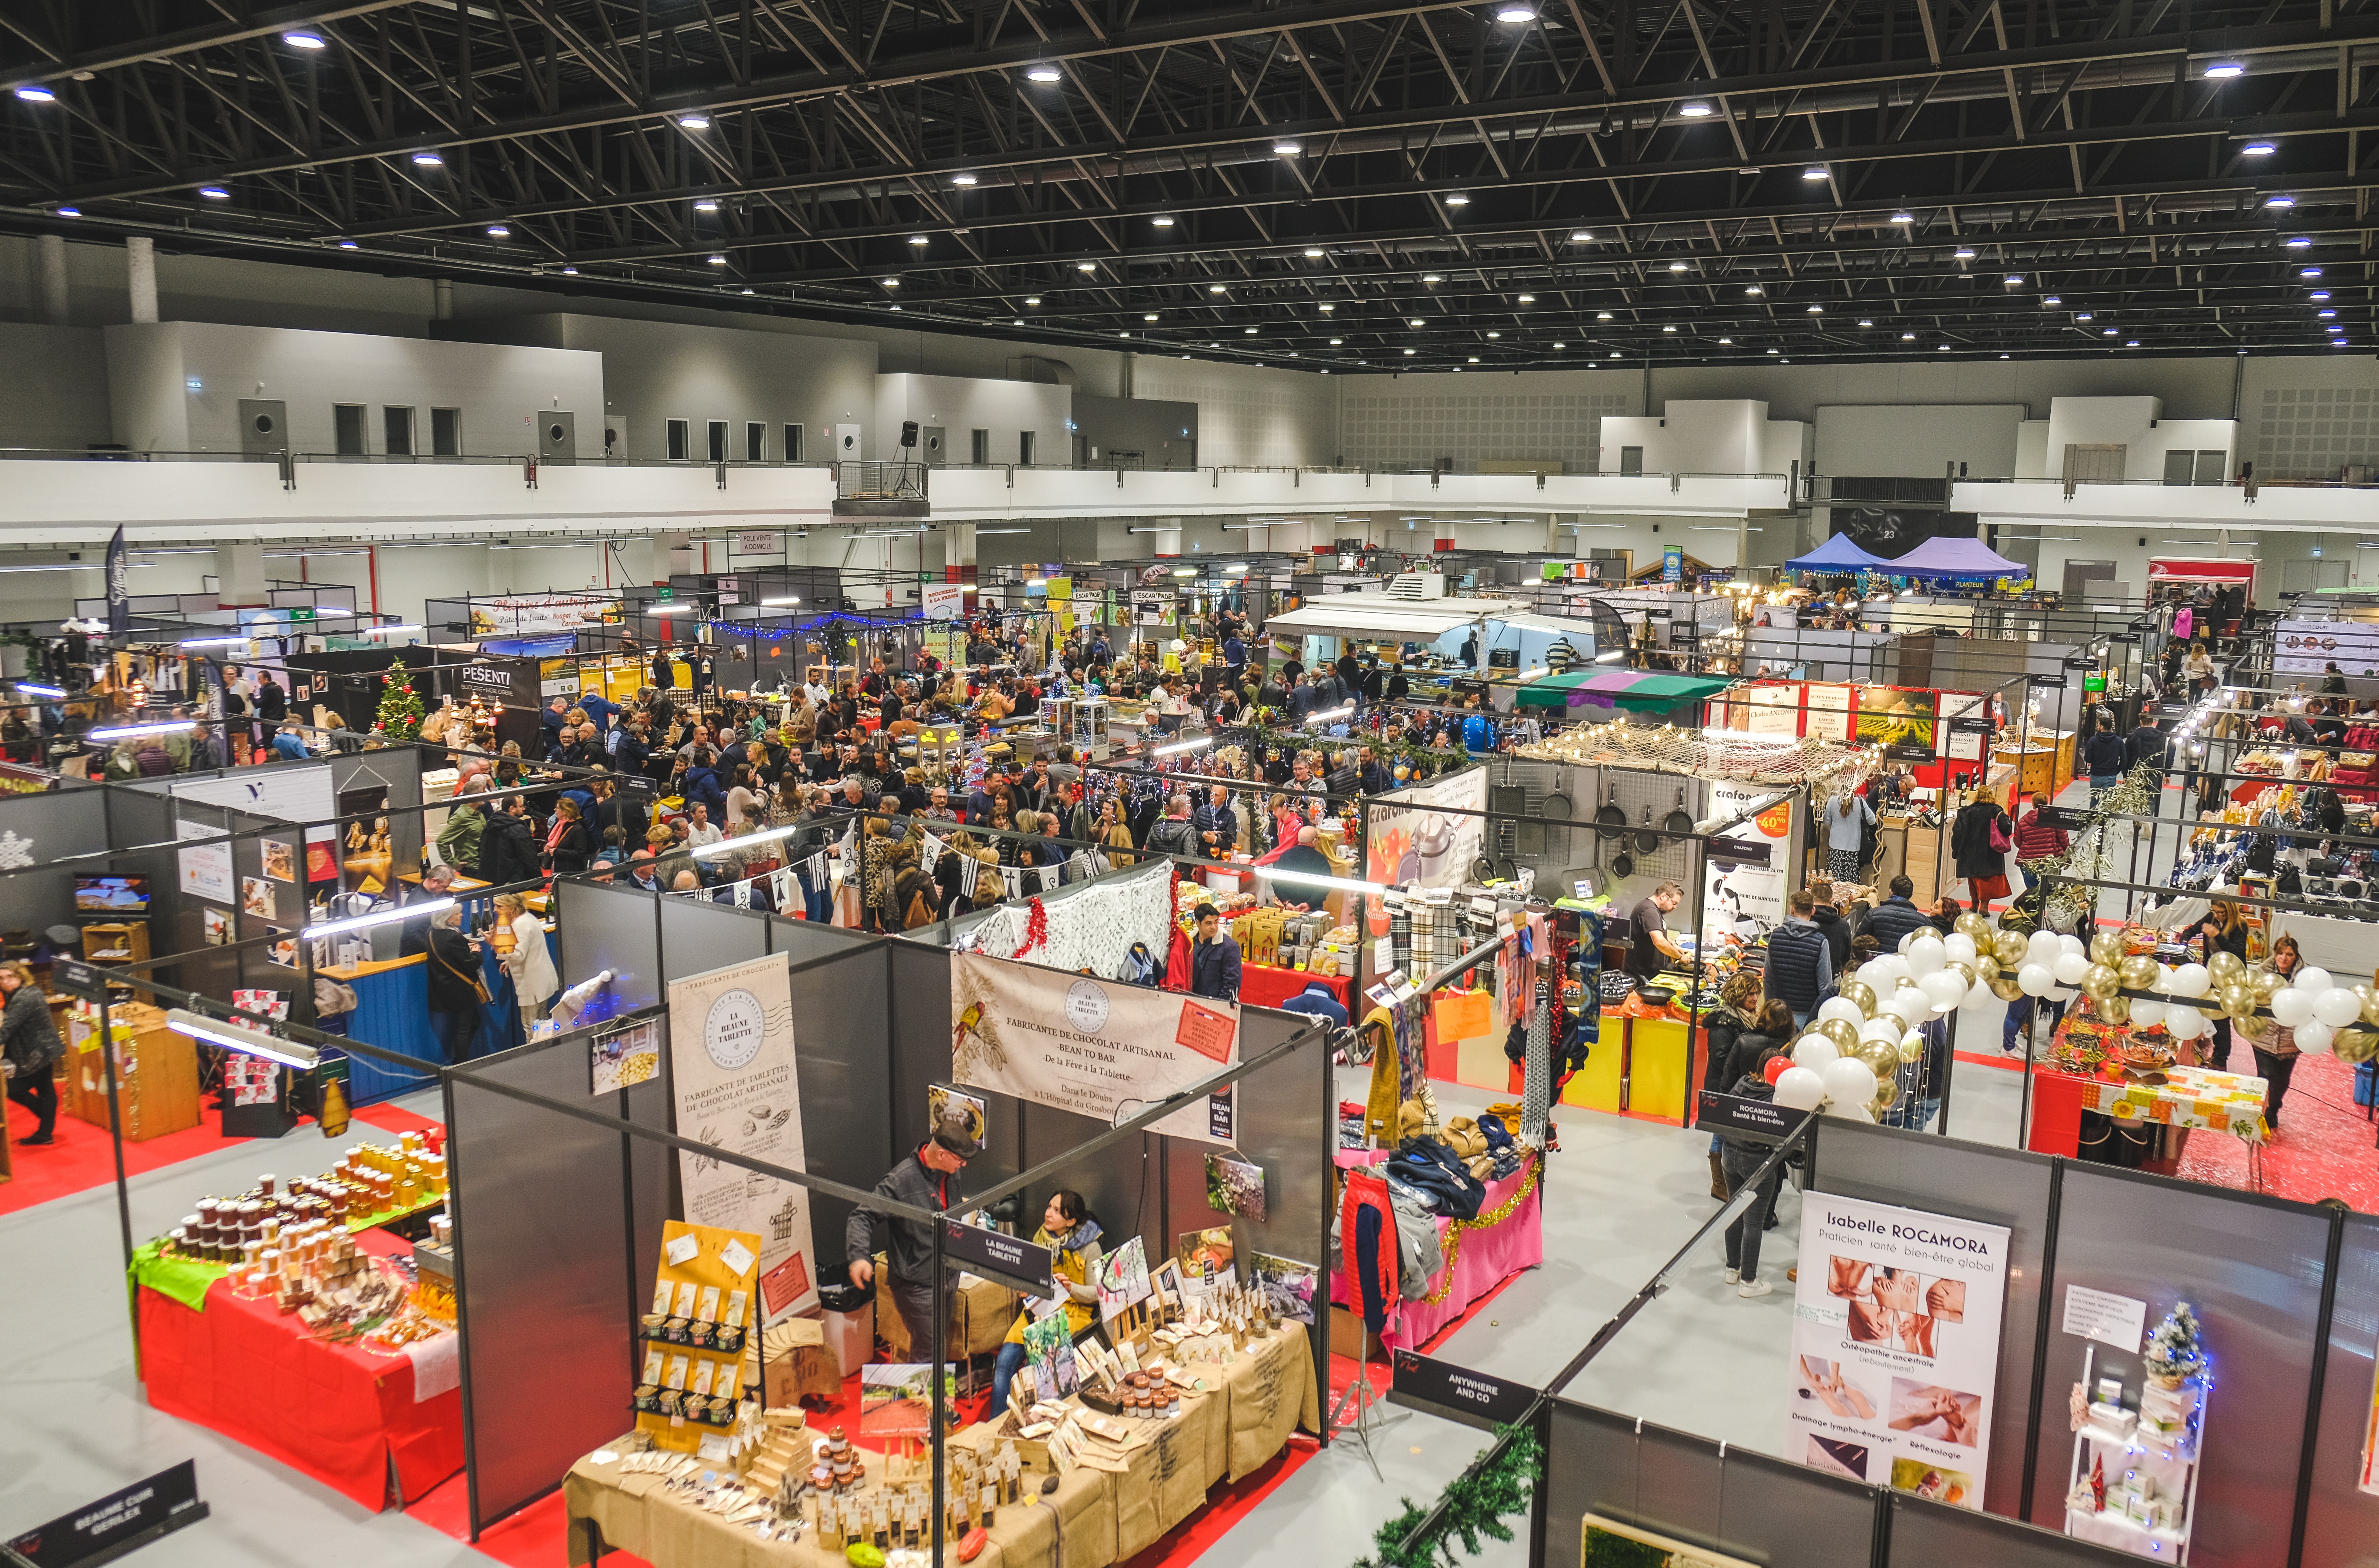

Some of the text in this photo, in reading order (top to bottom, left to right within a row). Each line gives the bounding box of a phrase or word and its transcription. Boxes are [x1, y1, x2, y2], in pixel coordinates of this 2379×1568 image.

[928, 588, 957, 598] BOUCHERIE
[528, 614, 547, 623] fruits
[1751, 709, 1768, 717] Charles
[690, 974, 729, 989] FABRICANTE
[742, 963, 775, 976] CHOCOLAT
[1075, 1006, 1099, 1016] TABLETTE
[1078, 1000, 1097, 1008] BEAUNE
[729, 1012, 738, 1021] LA
[721, 1019, 749, 1033] BEAUNE
[718, 1027, 753, 1043] TABLETTE
[1006, 1017, 1176, 1060] FABRICANTE DE CHOCOLAT ARTISANAL
[1084, 1049, 1095, 1058] TO
[1057, 1057, 1063, 1066] la
[1084, 1063, 1088, 1071] à
[1090, 1064, 1097, 1074] la
[685, 1064, 789, 1103] FABRICANTE DE TABLETTES
[686, 1073, 790, 1113] DE CHOCOLAT ARTISANALE
[1061, 1084, 1113, 1103] Dans le Doubs
[1074, 1100, 1084, 1109] du
[1211, 1102, 1230, 1112] BEAN
[1739, 1105, 1778, 1117] ROCAMORA
[1214, 1114, 1228, 1123] BAR
[1732, 1111, 1750, 1120] Santé
[1212, 1126, 1230, 1134] FRANCE
[1827, 1211, 1989, 1255] Isabelle ROCAMORA
[986, 1238, 1023, 1256] LA BEAUNE
[1819, 1228, 1994, 1273] Praticien santé bien-être global
[987, 1247, 1021, 1265] TABLETTE
[1840, 1341, 1935, 1369] Ostéopathie ancestrale
[1859, 1355, 1915, 1374] (reboutement)
[1448, 1373, 1498, 1396] ANYWHERE
[1456, 1386, 1490, 1403] AND CO
[1791, 1412, 1828, 1427] Drainage
[1909, 1440, 1962, 1460] Réflexologie
[74, 1499, 125, 1531] BEAUNE
